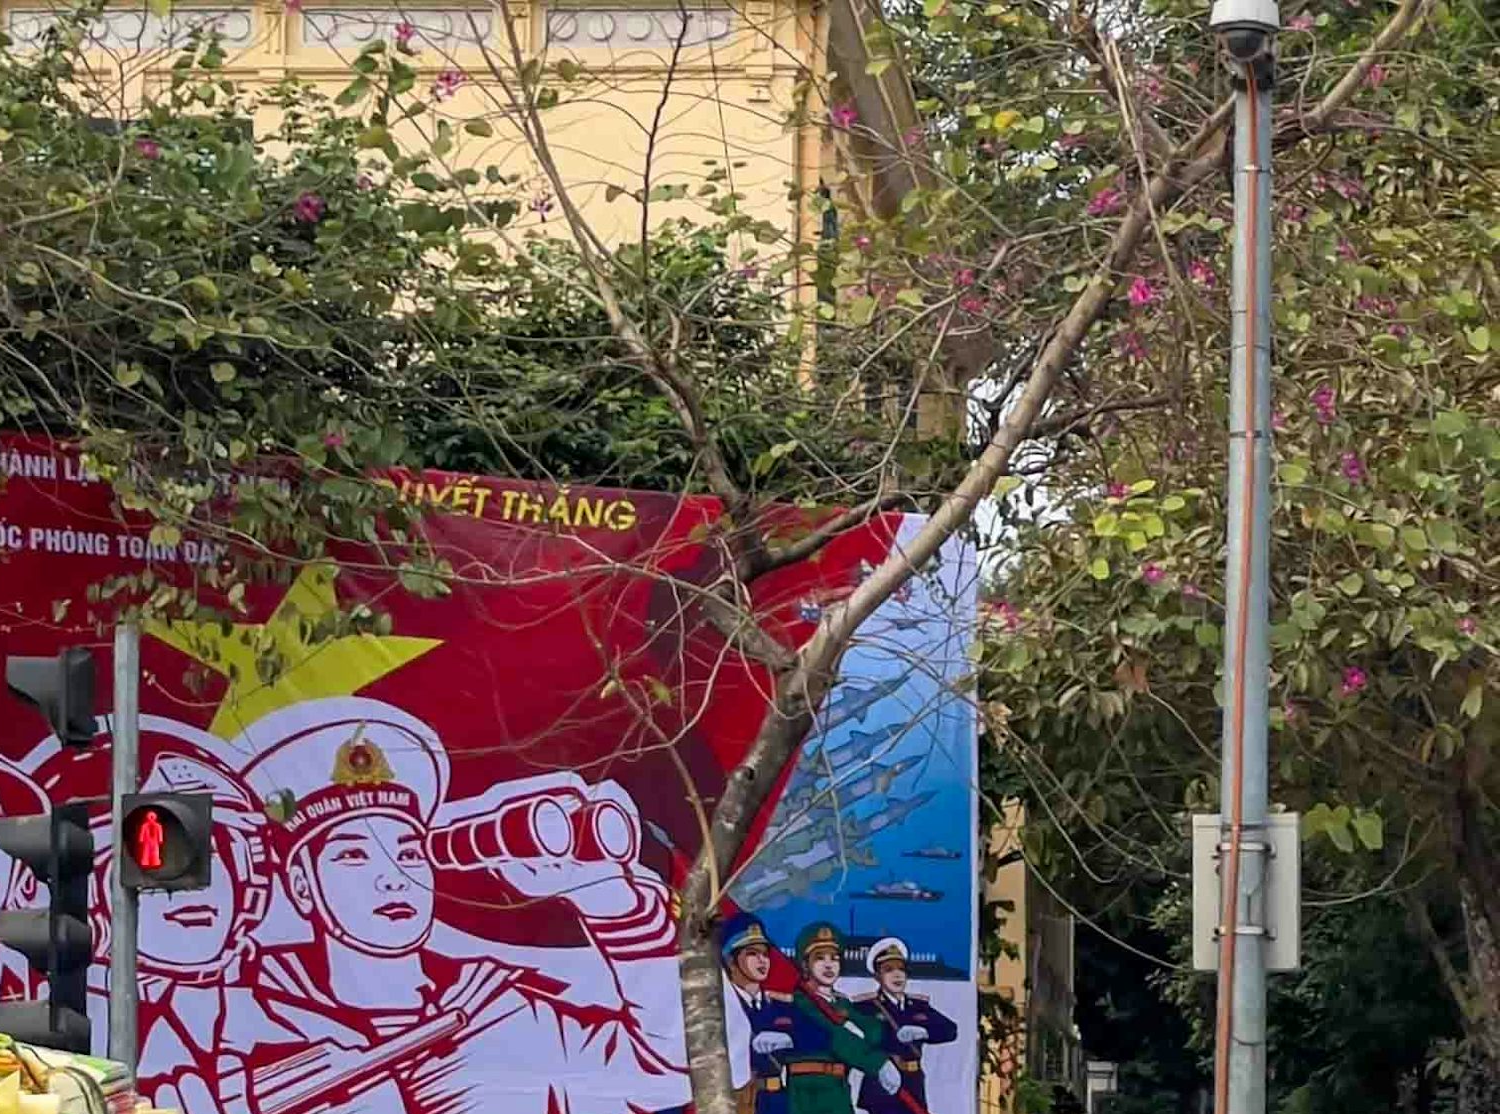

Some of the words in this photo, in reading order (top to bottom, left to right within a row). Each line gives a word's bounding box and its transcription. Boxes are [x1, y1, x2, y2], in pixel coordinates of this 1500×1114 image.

[376, 475, 493, 519] UYẾT
[501, 483, 636, 531] THẮNG
[30, 525, 109, 555] PHÒNG
[377, 790, 411, 806] NAM
